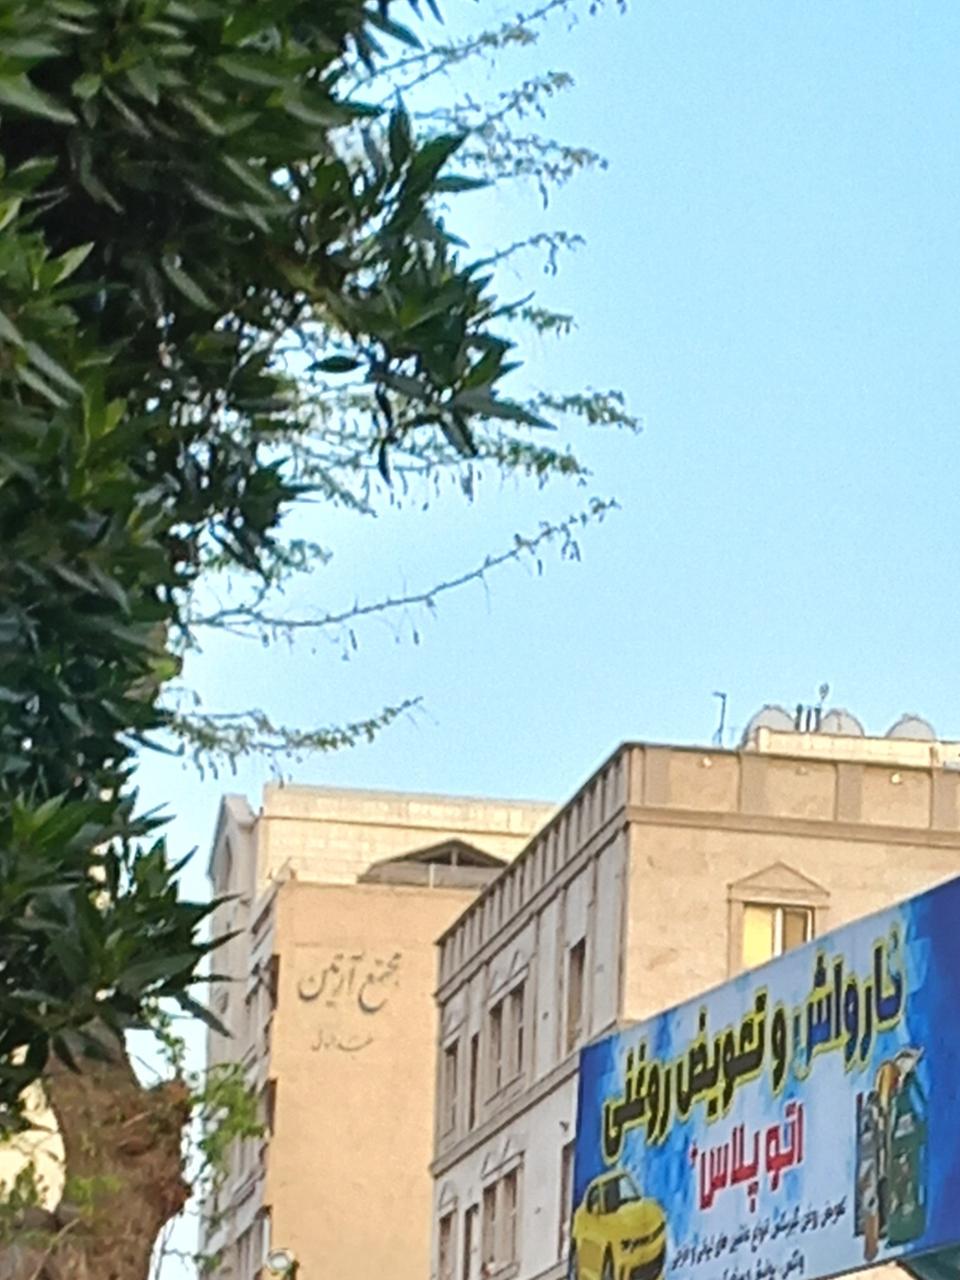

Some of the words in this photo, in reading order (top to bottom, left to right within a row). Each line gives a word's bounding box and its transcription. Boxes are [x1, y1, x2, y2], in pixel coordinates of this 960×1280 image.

[674, 984, 768, 1122] تعویض
[769, 1000, 788, 1095] و
[791, 920, 906, 1081] کارواش
